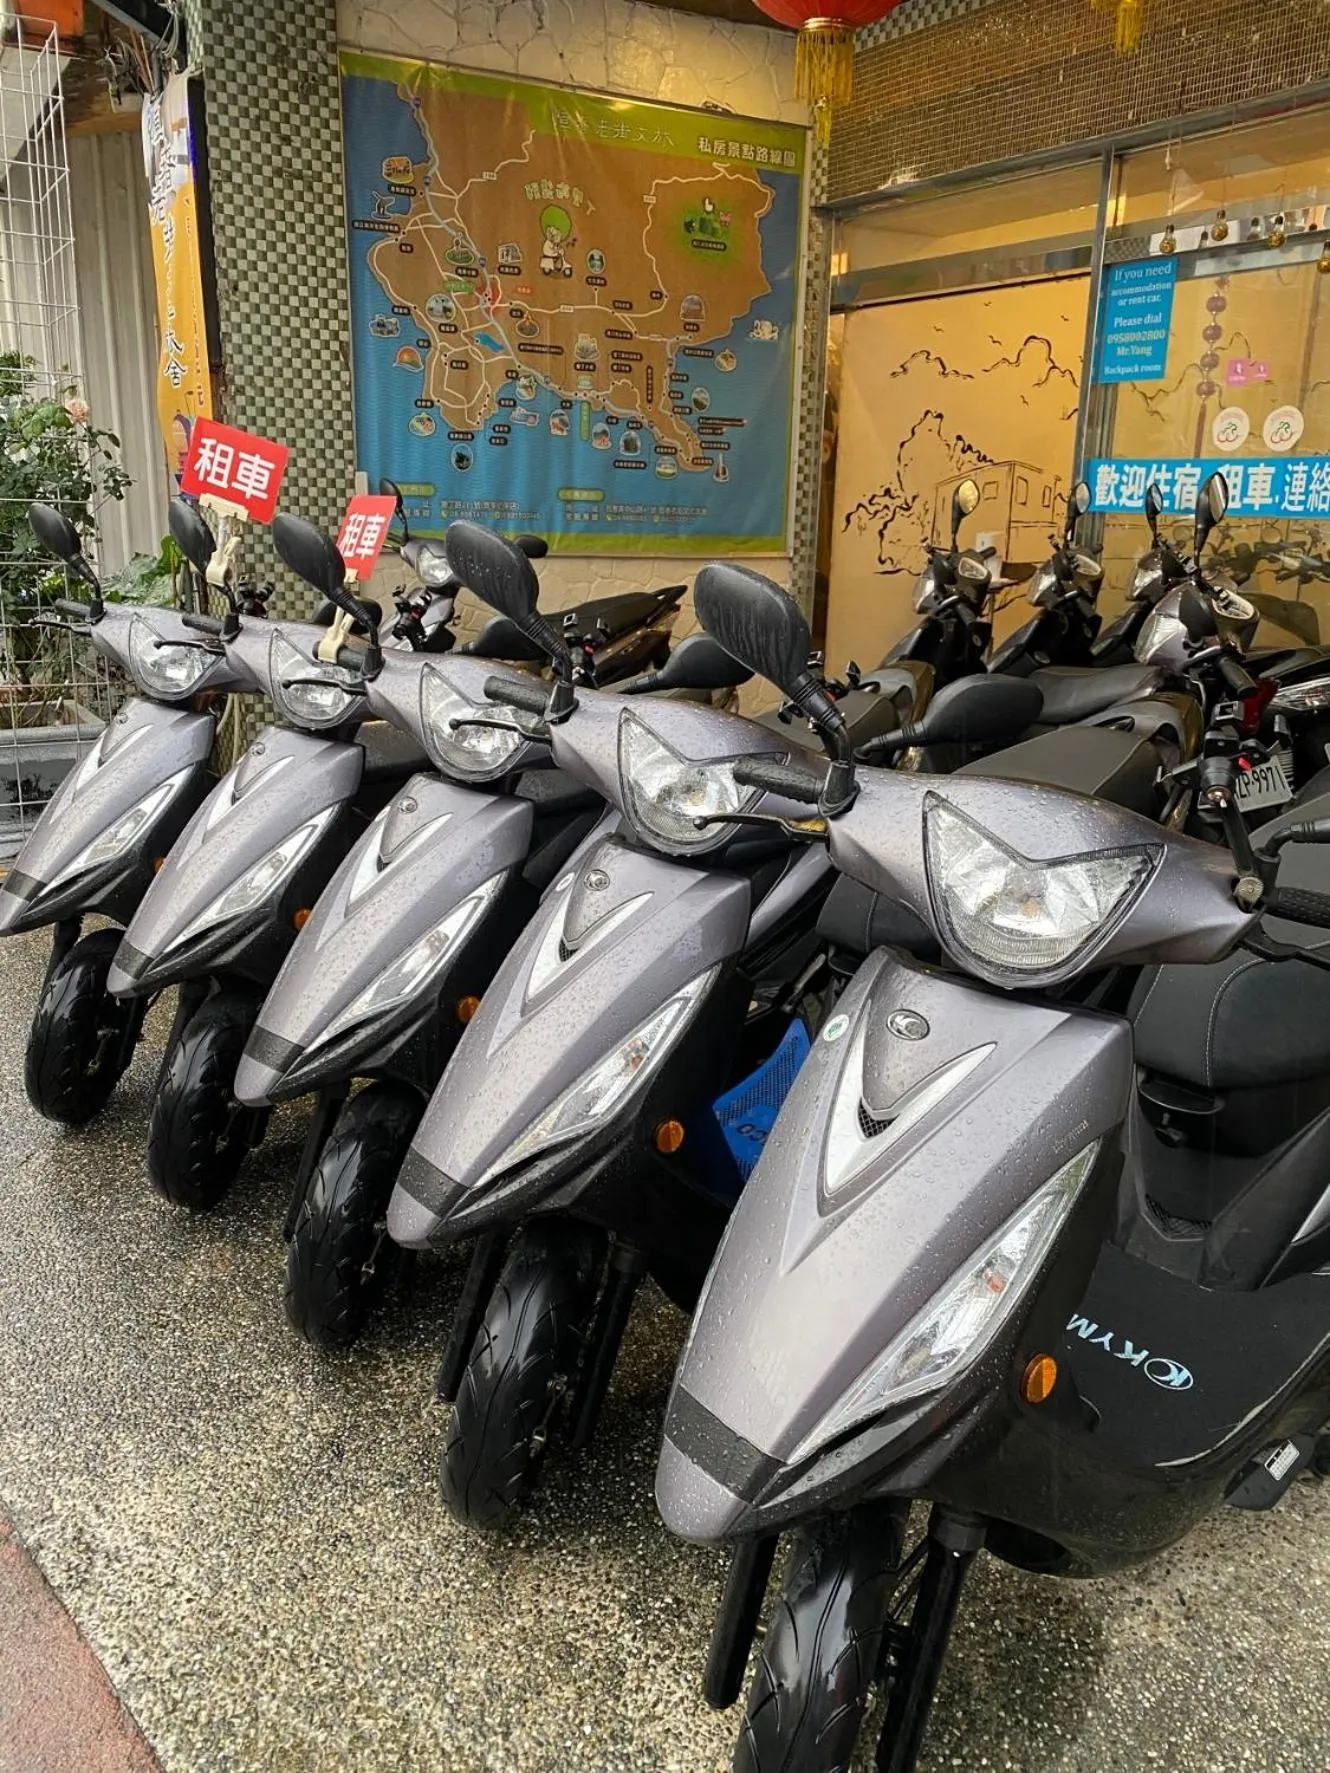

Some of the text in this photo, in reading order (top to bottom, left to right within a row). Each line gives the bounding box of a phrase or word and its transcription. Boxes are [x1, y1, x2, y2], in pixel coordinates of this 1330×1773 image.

[1115, 261, 1172, 283] If you need
[1129, 295, 1146, 305] rent
[1114, 313, 1162, 328] Please dial
[1104, 363, 1162, 376] Backpack room
[193, 437, 276, 500] 租車
[338, 512, 386, 560] 租車
